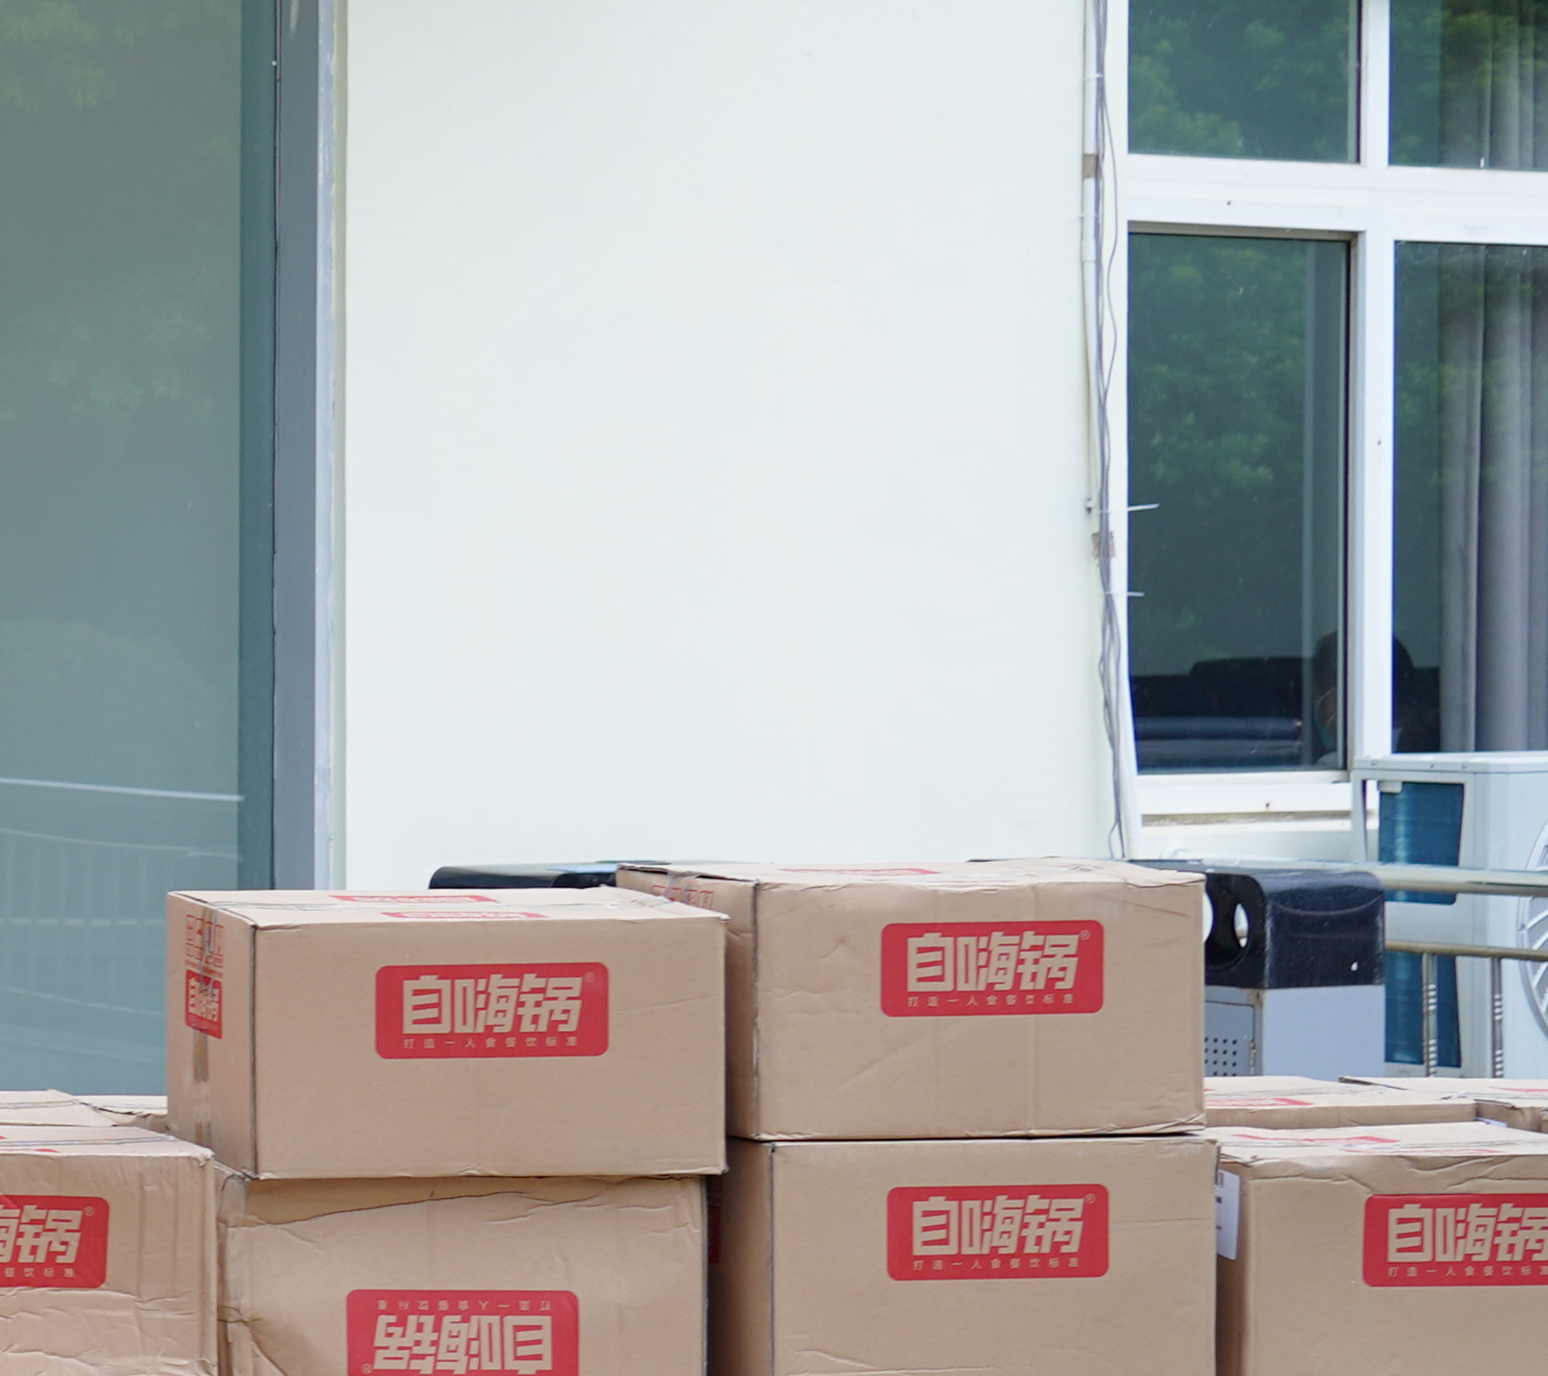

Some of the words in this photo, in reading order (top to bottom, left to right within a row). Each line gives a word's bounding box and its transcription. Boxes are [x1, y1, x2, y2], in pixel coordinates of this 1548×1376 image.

[906, 931, 1080, 992] 自嗨锅
[402, 973, 583, 1034] 自嗨锅
[912, 1194, 1085, 1255] 自嗨锅
[1387, 1203, 1548, 1263] 自嗨锅
[373, 1315, 552, 1375] 自嗨锅
